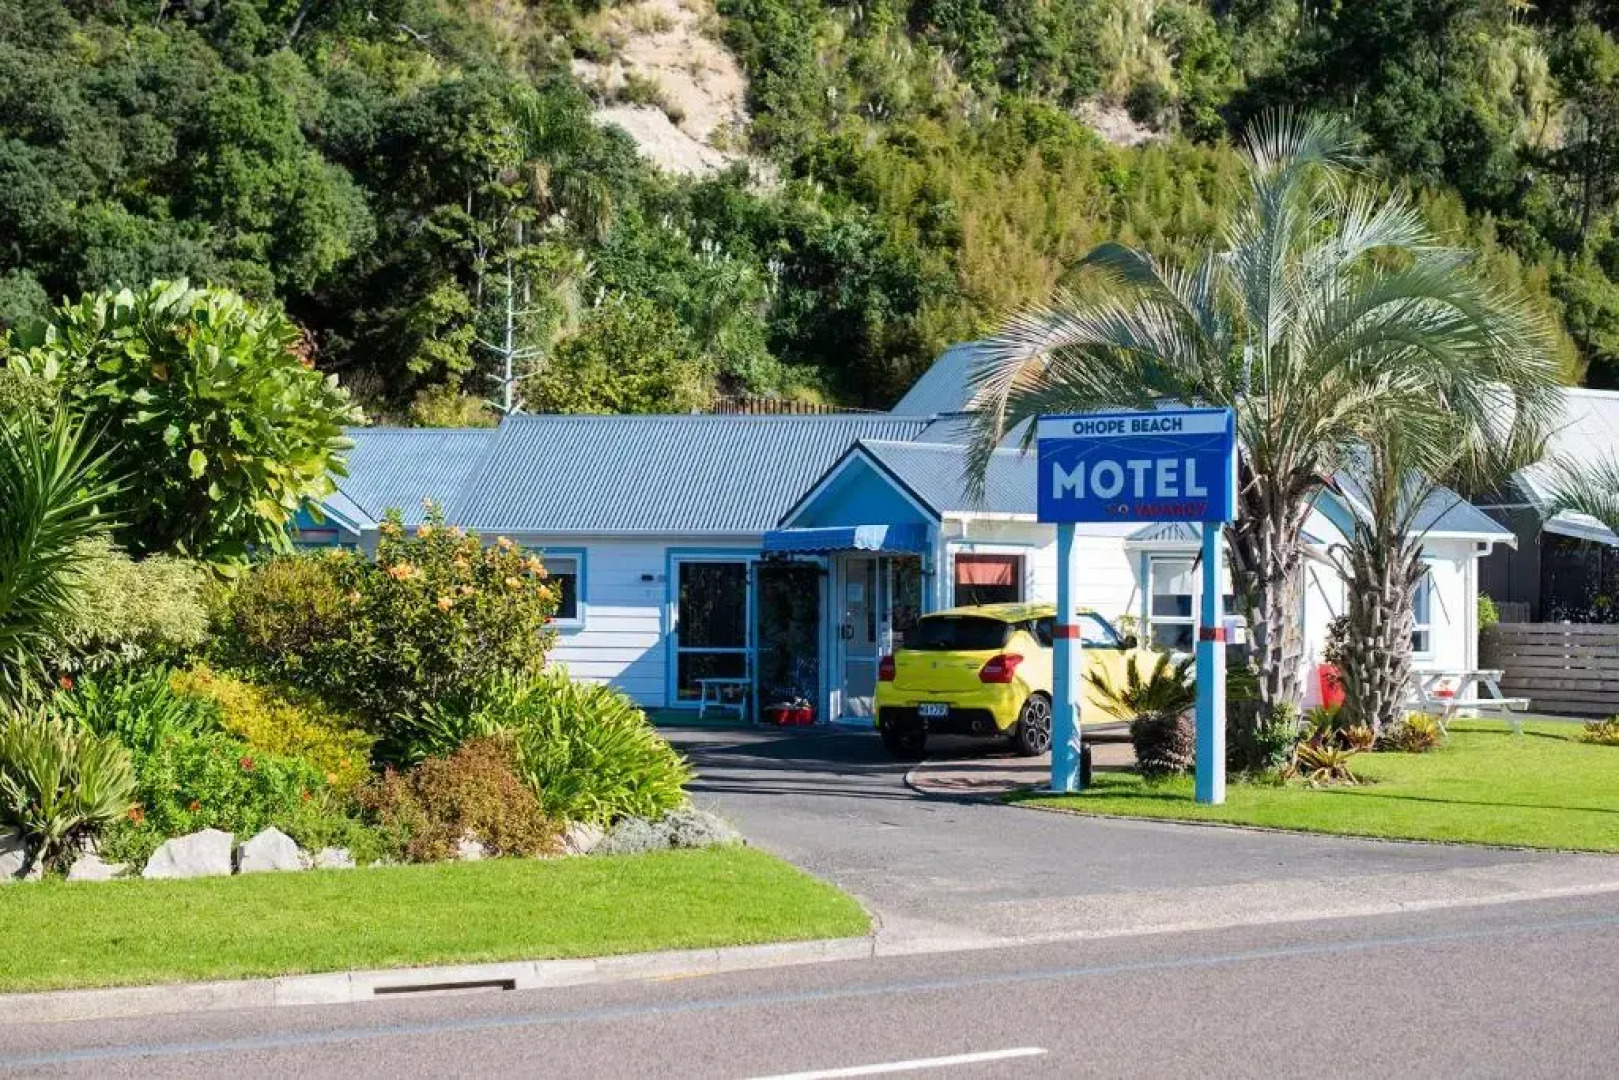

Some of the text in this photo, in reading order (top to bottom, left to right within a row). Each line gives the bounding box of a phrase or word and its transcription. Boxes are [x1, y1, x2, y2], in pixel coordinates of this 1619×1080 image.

[1073, 417, 1182, 435] OHOPE BEACH
[1053, 458, 1208, 499] MOTEL
